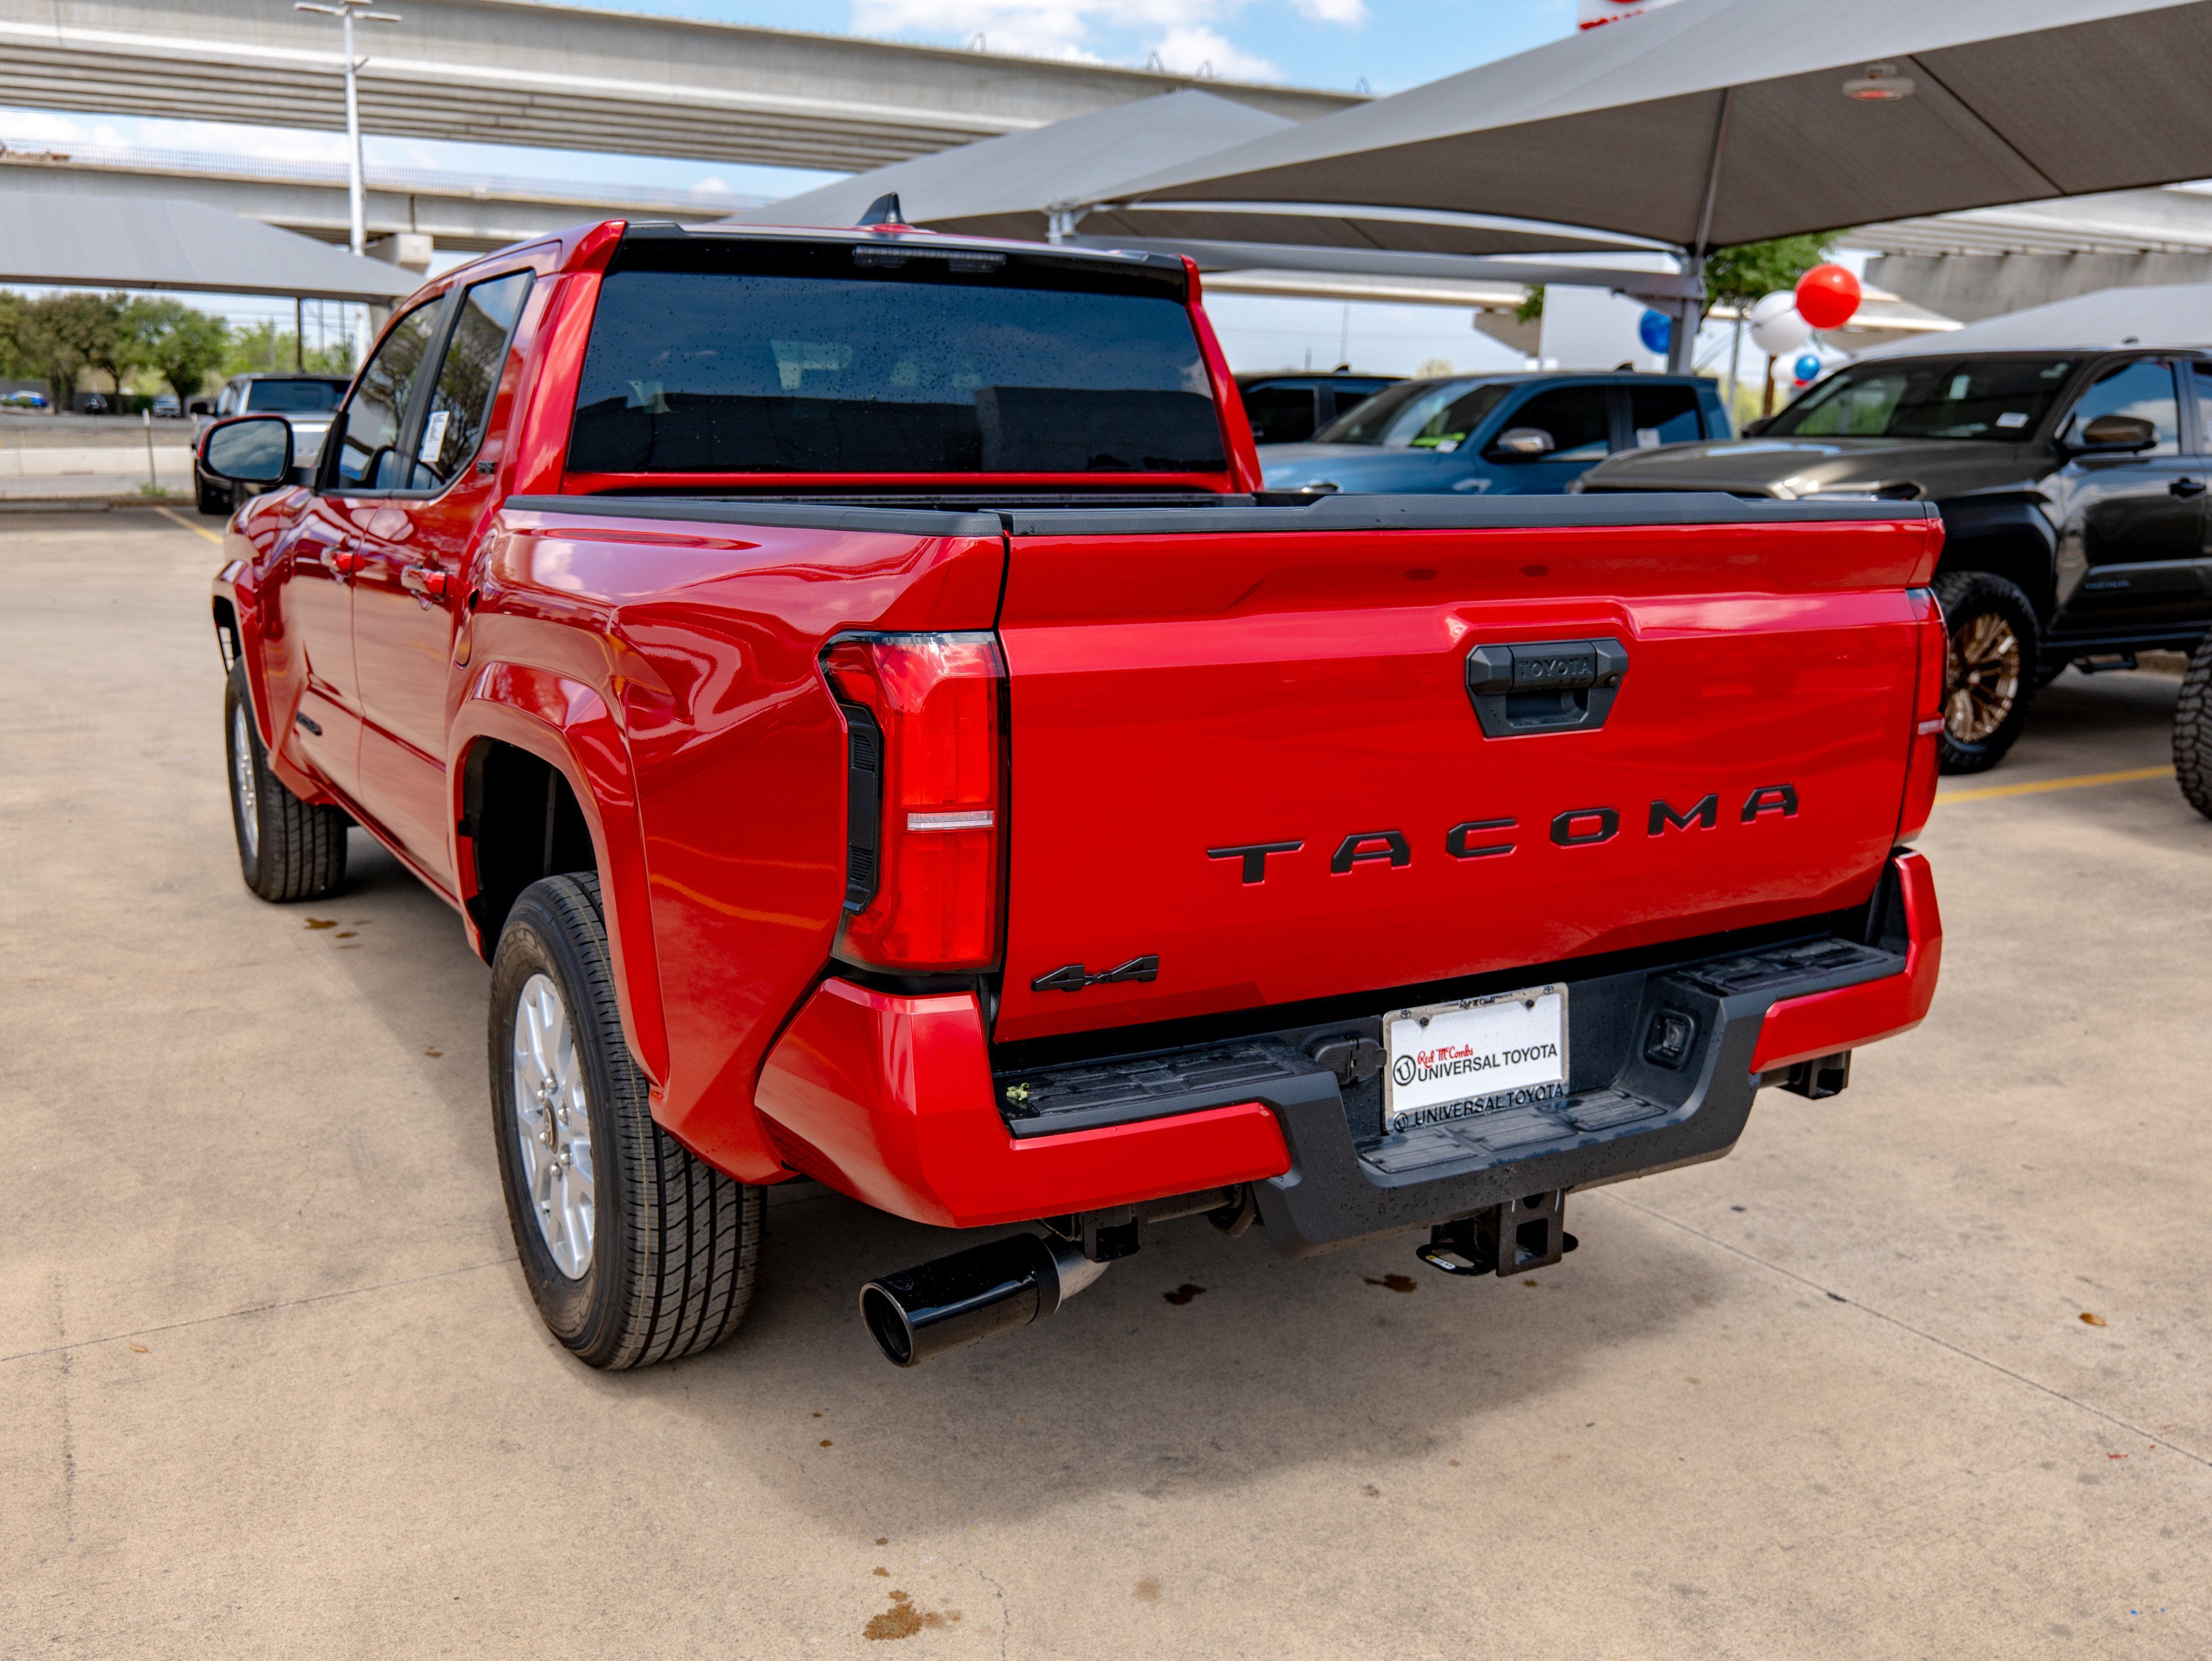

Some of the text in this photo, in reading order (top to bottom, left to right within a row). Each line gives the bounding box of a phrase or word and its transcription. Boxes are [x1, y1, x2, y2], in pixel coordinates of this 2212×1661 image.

[1519, 657, 1592, 678] TOYOTA
[1207, 783, 1799, 886] TACOMA
[1417, 1050, 1435, 1069] Red
[1418, 1054, 1501, 1081] UNIVERSAL
[1502, 1043, 1558, 1065] TOYOTA
[1415, 1095, 1505, 1125] UNIVERSAL
[1505, 1081, 1563, 1107] TOYOTA
